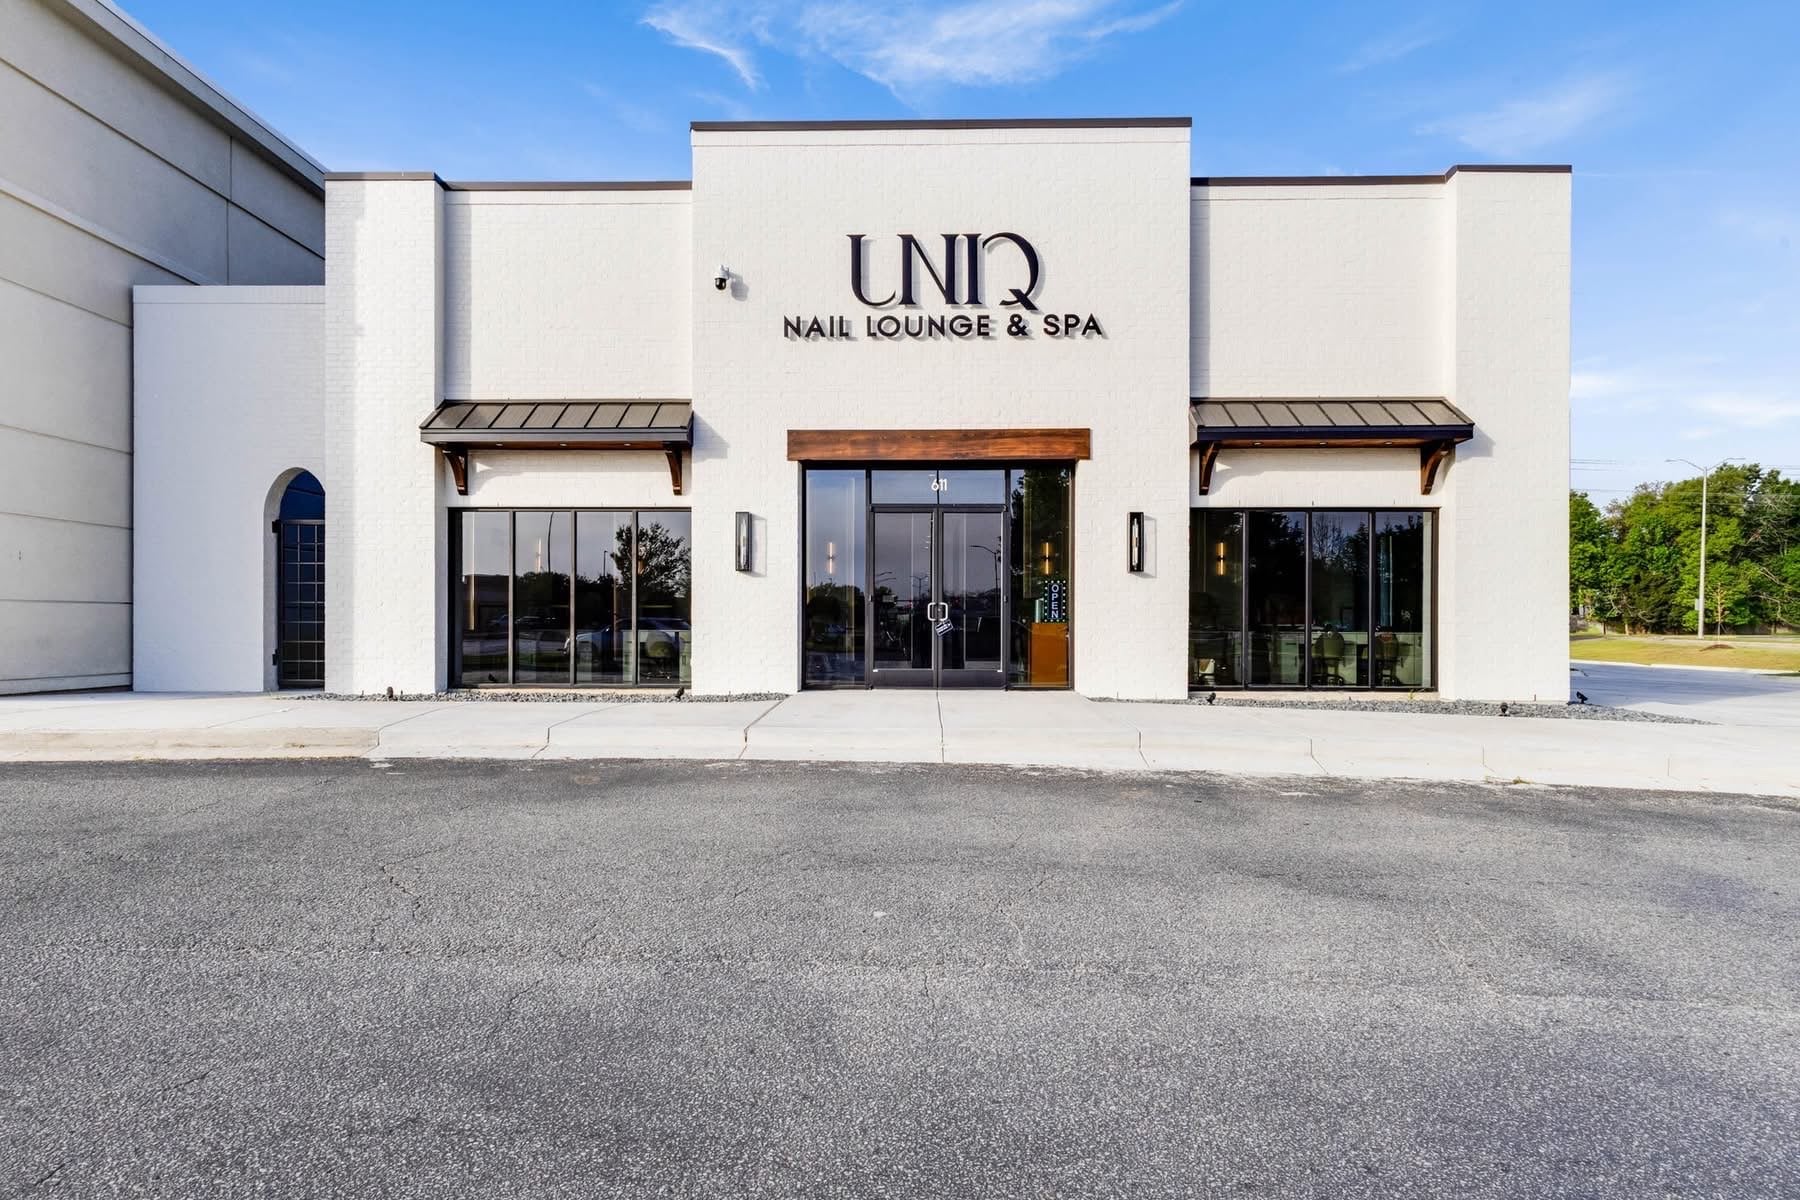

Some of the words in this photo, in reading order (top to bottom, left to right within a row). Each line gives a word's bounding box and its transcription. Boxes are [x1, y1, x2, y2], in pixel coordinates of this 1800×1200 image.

[846, 232, 1039, 311] UNIQ
[783, 315, 849, 338] NAIL
[866, 314, 990, 338] LOUNGE
[1006, 313, 1029, 336] &
[1043, 313, 1102, 336] SPA
[931, 478, 947, 491] 611
[1051, 584, 1060, 619] OPEN
